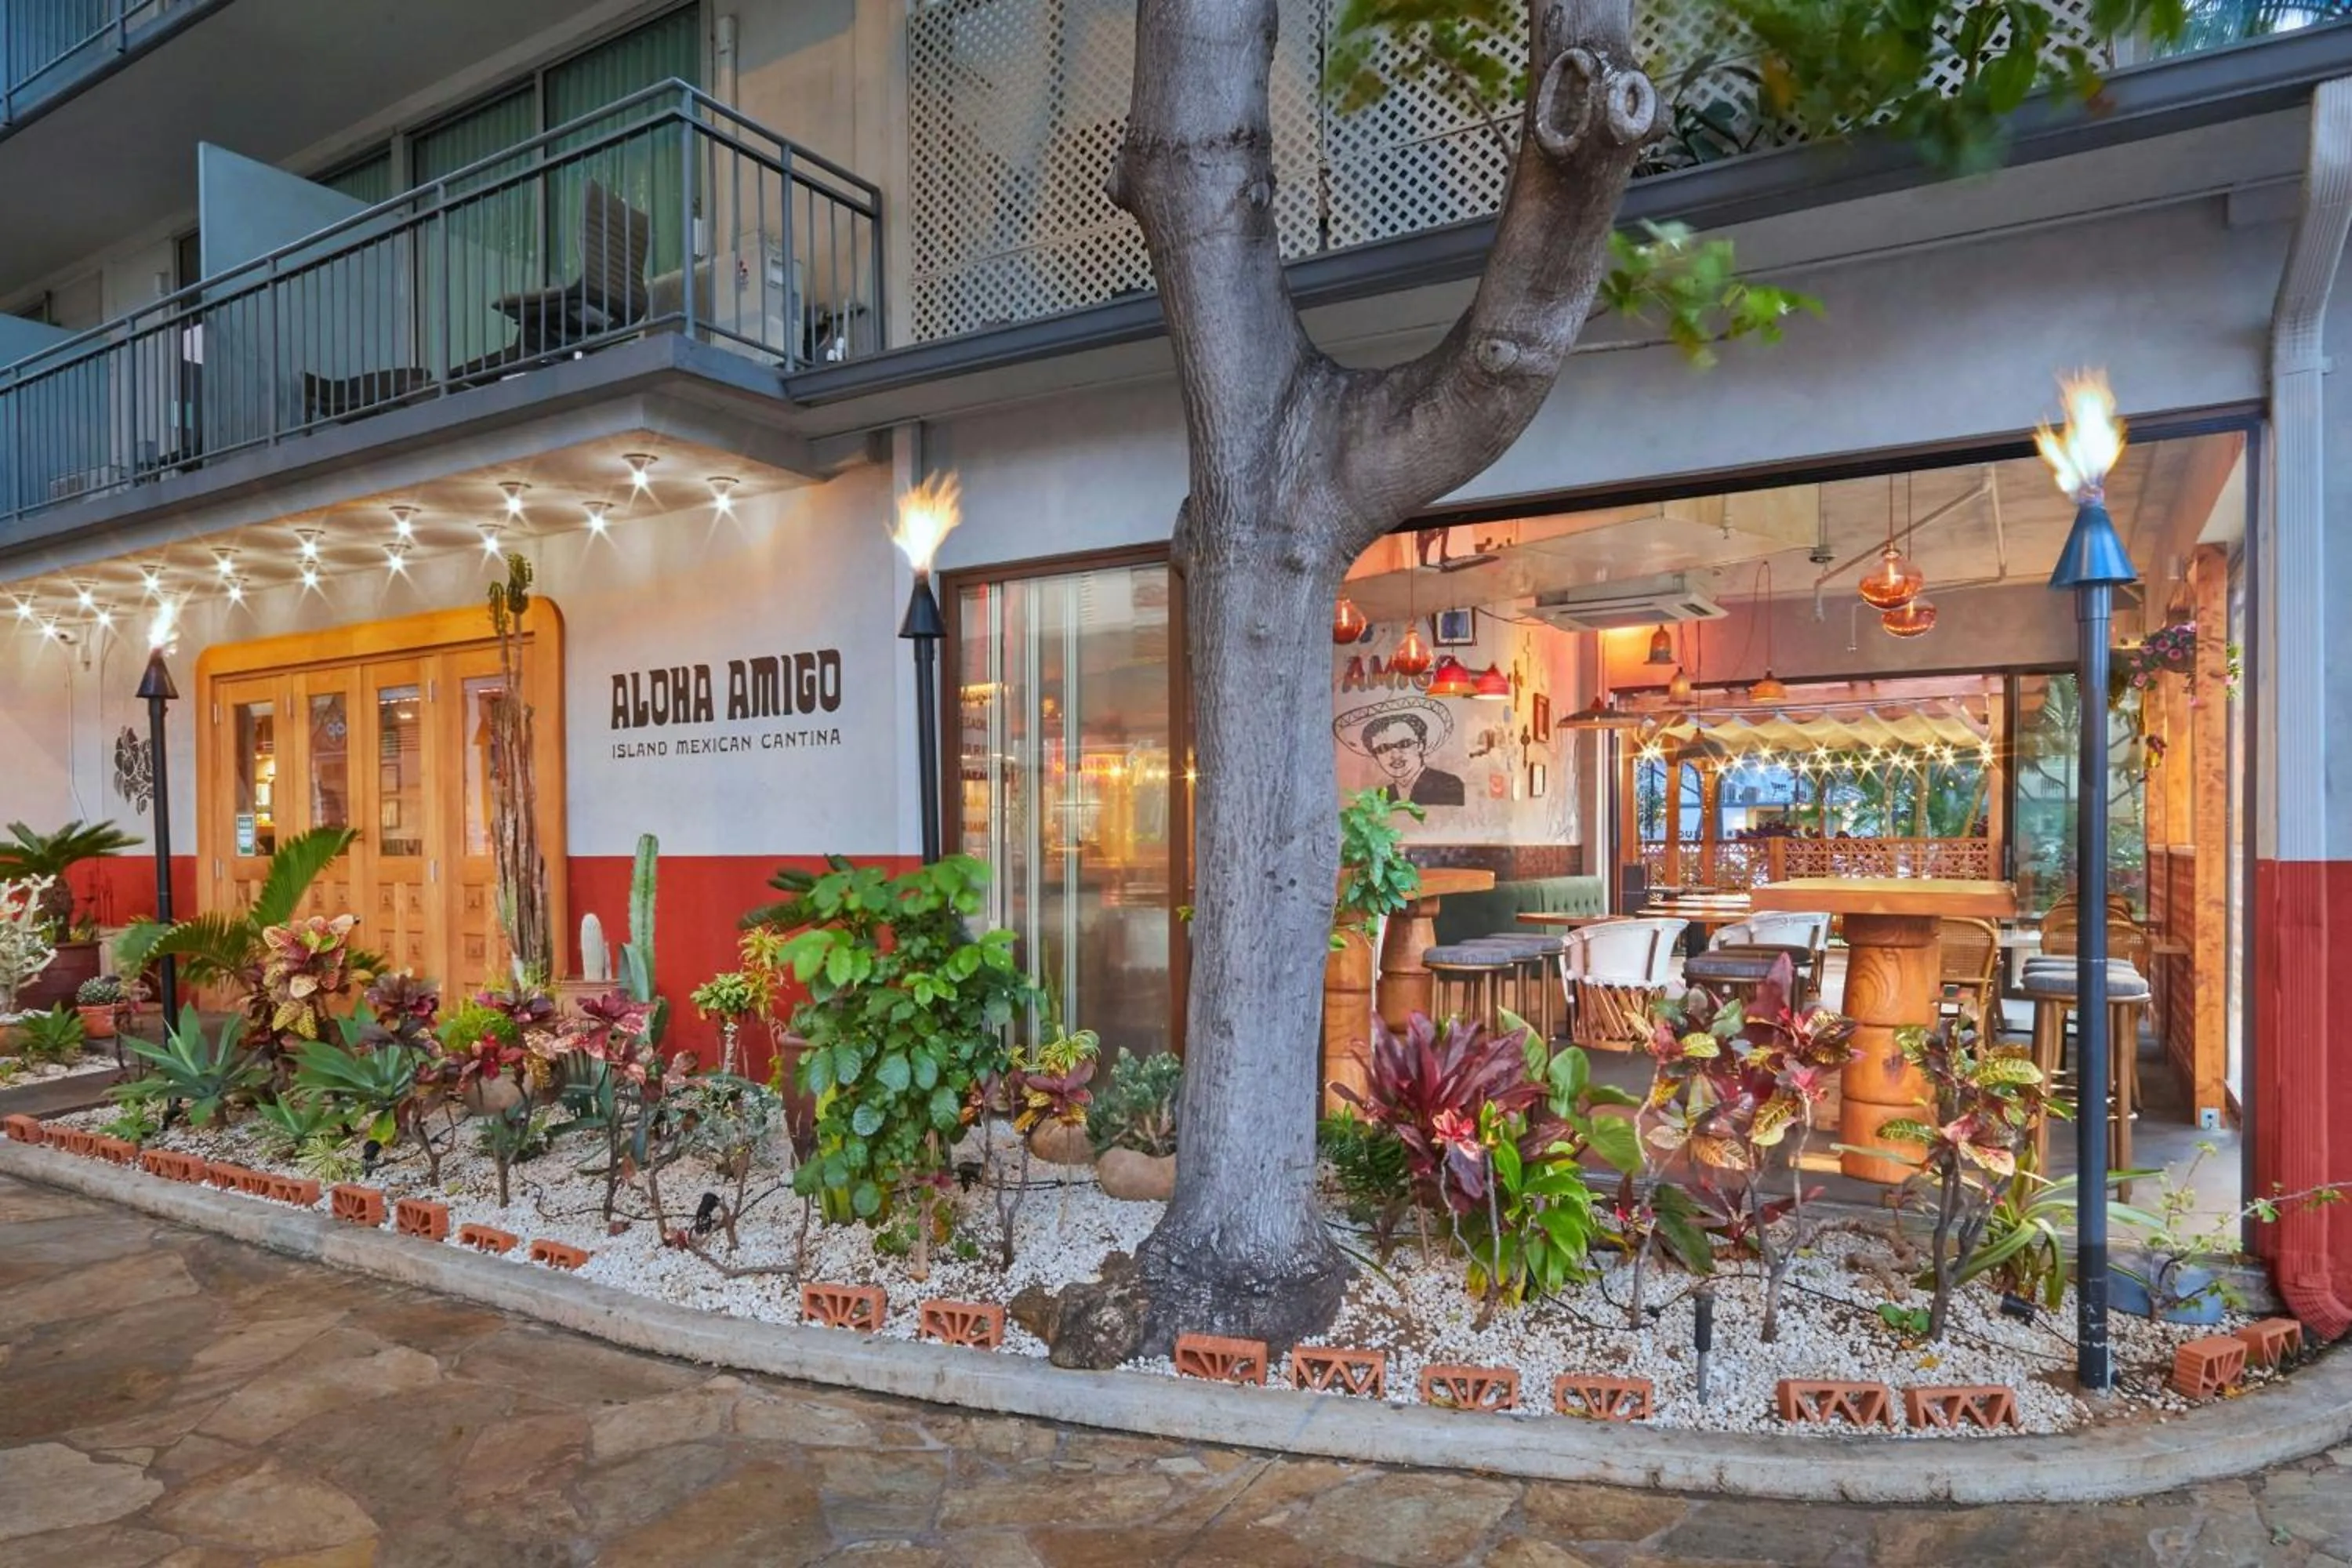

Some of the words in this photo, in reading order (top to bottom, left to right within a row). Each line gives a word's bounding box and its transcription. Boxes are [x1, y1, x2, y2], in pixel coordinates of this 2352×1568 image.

[610, 663, 715, 730] ALOHA
[727, 648, 843, 720] AMIGO
[611, 740, 668, 760] ISLAND
[675, 735, 752, 755] MEXICAN
[760, 728, 842, 750] CANTINA
